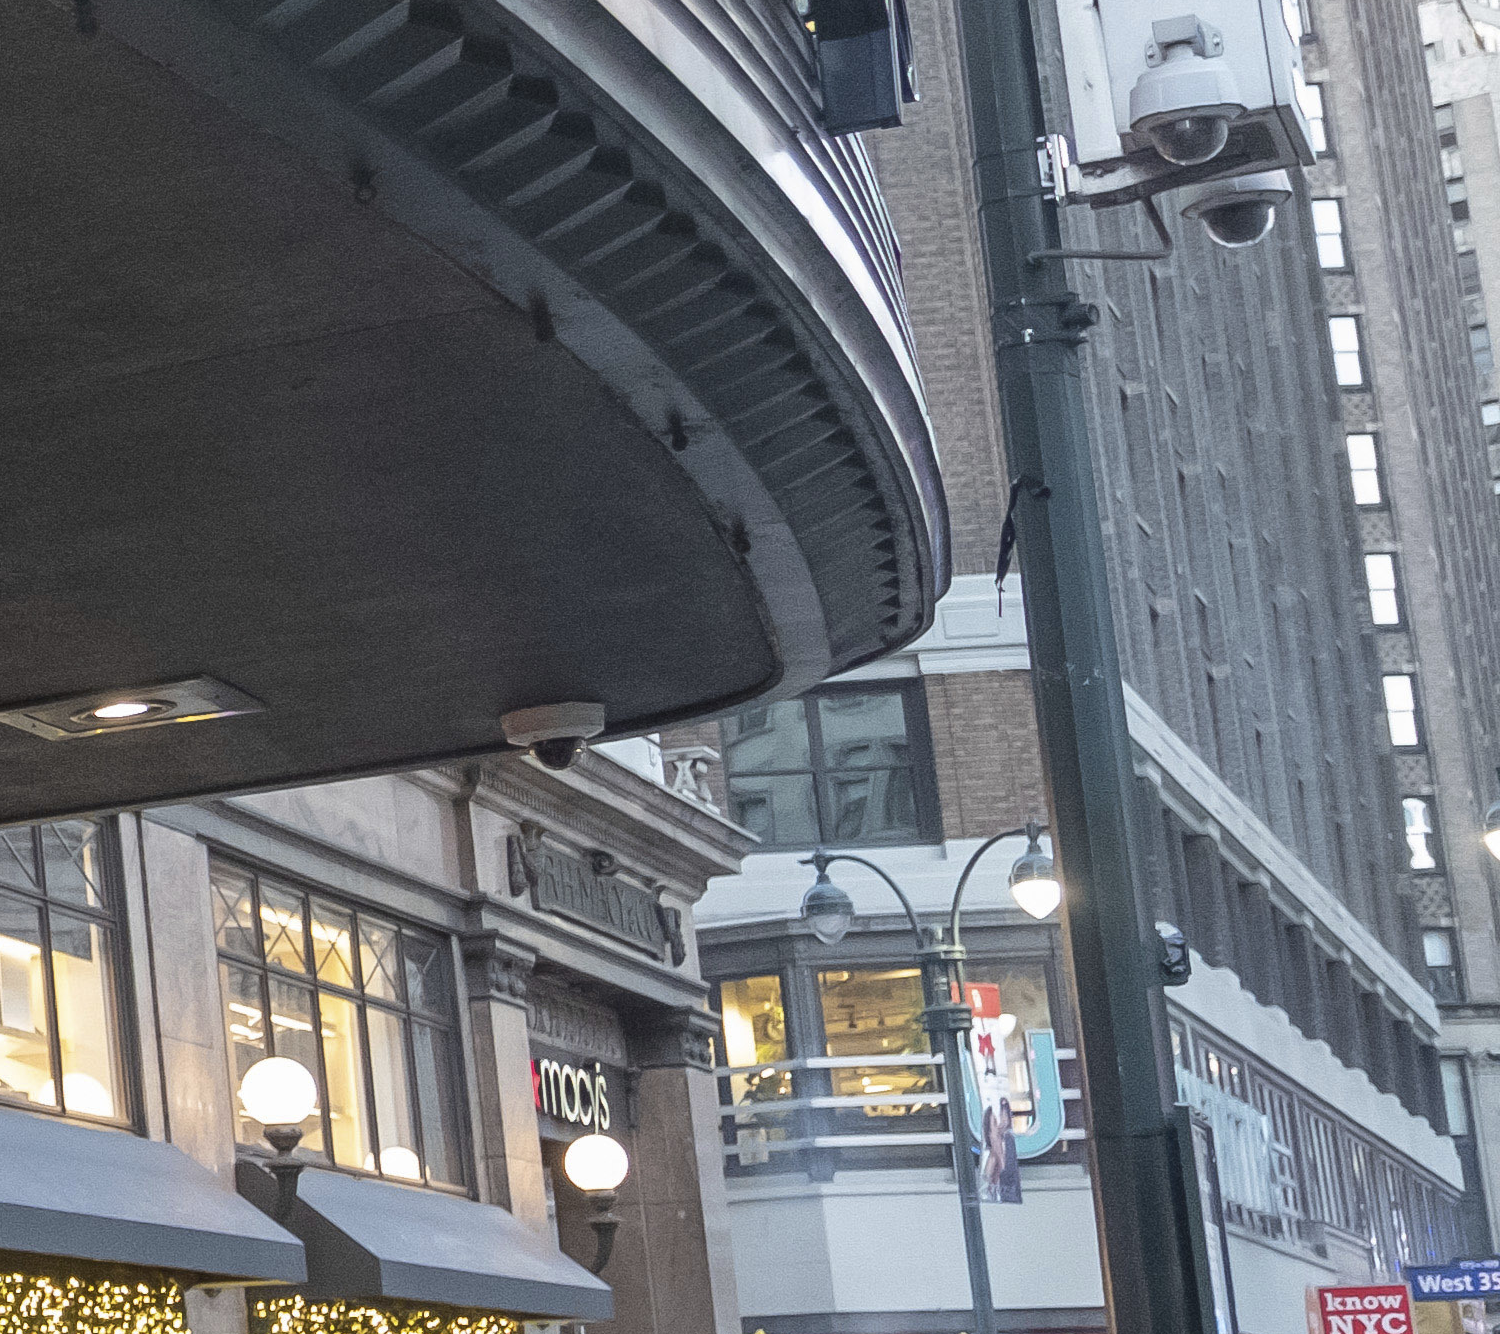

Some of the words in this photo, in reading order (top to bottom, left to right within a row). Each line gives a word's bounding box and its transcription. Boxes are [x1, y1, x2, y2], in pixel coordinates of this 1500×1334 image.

[540, 1058, 610, 1135] macy's
[1418, 1274, 1475, 1293] West
[1324, 1293, 1402, 1311] know
